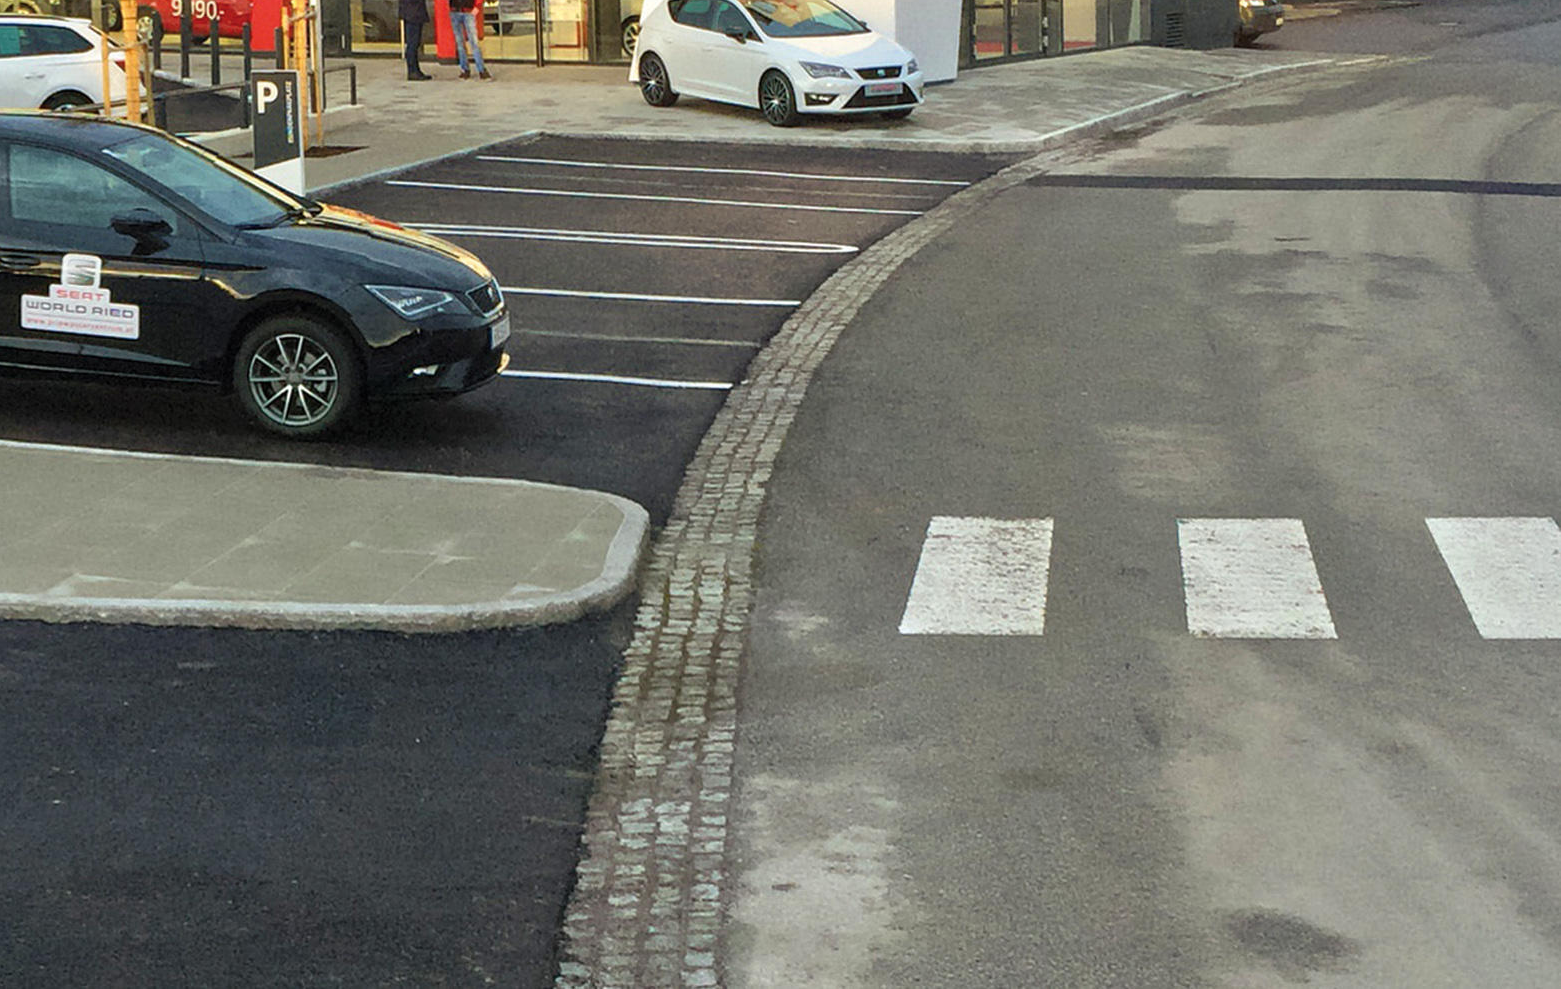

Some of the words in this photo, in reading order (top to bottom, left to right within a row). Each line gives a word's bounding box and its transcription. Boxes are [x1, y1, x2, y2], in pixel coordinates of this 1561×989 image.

[257, 81, 278, 114] P
[56, 289, 104, 301] SEAT
[26, 301, 87, 314] WORLD
[92, 307, 134, 318] RIED
